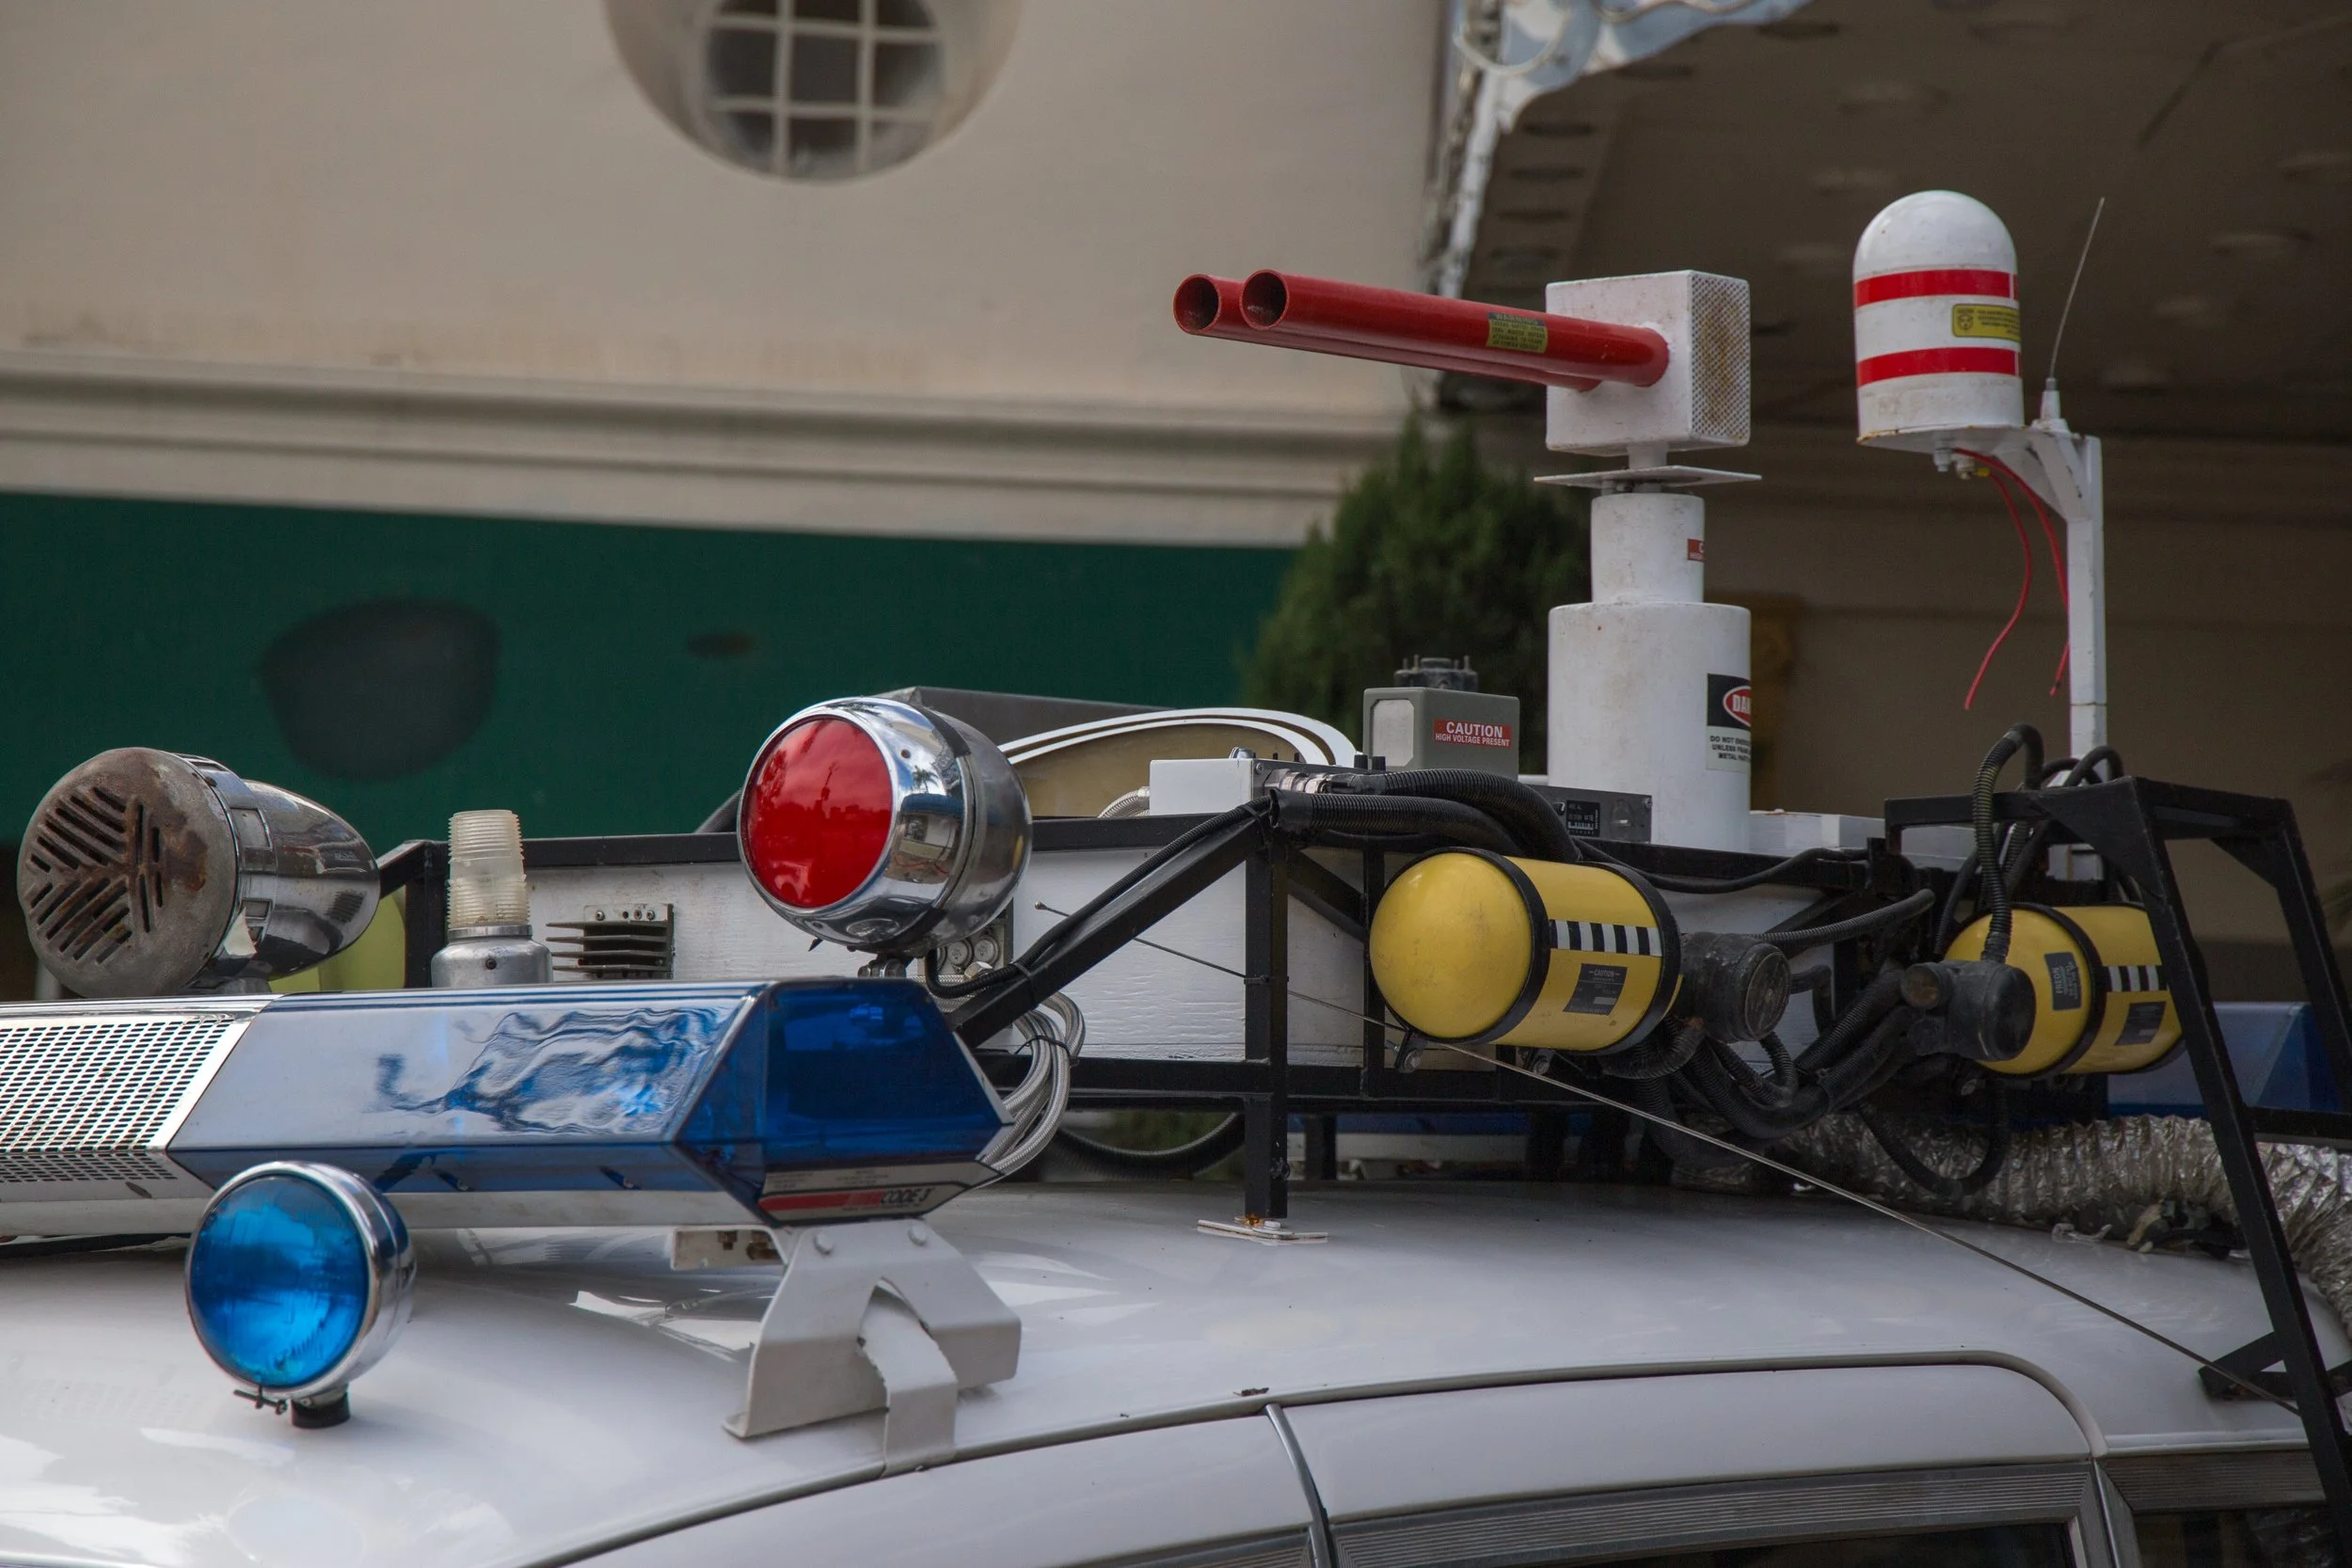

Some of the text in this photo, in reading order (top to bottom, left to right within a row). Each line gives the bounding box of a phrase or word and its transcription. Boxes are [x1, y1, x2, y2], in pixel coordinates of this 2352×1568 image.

[1446, 721, 1502, 738] CAUTION
[1435, 733, 1510, 747] HIGH VOLTAGE PRESENT
[1594, 969, 1615, 977] CAUTION
[881, 1188, 922, 1204] CODE
